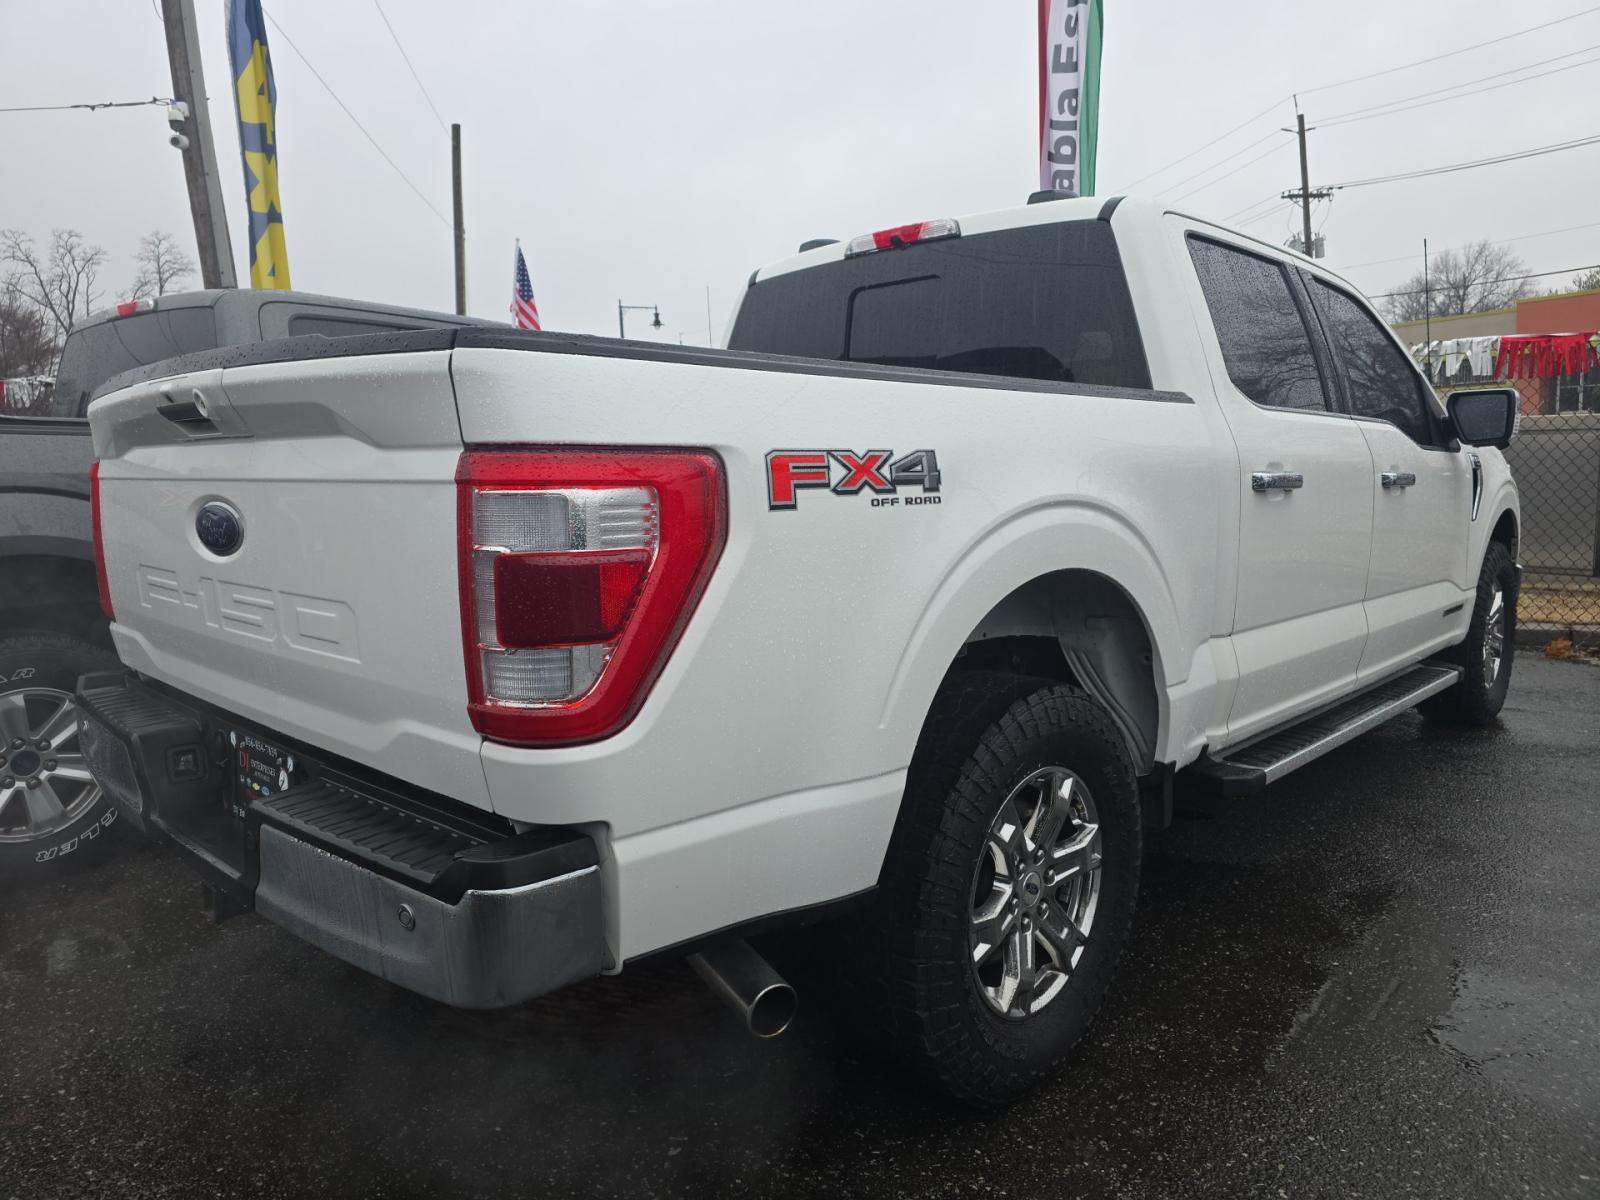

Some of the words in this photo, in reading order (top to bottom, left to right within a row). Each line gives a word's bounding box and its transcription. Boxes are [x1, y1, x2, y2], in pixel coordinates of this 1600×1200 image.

[1052, 0, 1088, 73] Es
[1047, 88, 1079, 191] abla
[765, 449, 941, 511] FX4
[871, 498, 900, 507] OFF
[905, 496, 942, 505] ROAD
[35, 808, 118, 862] GLER
